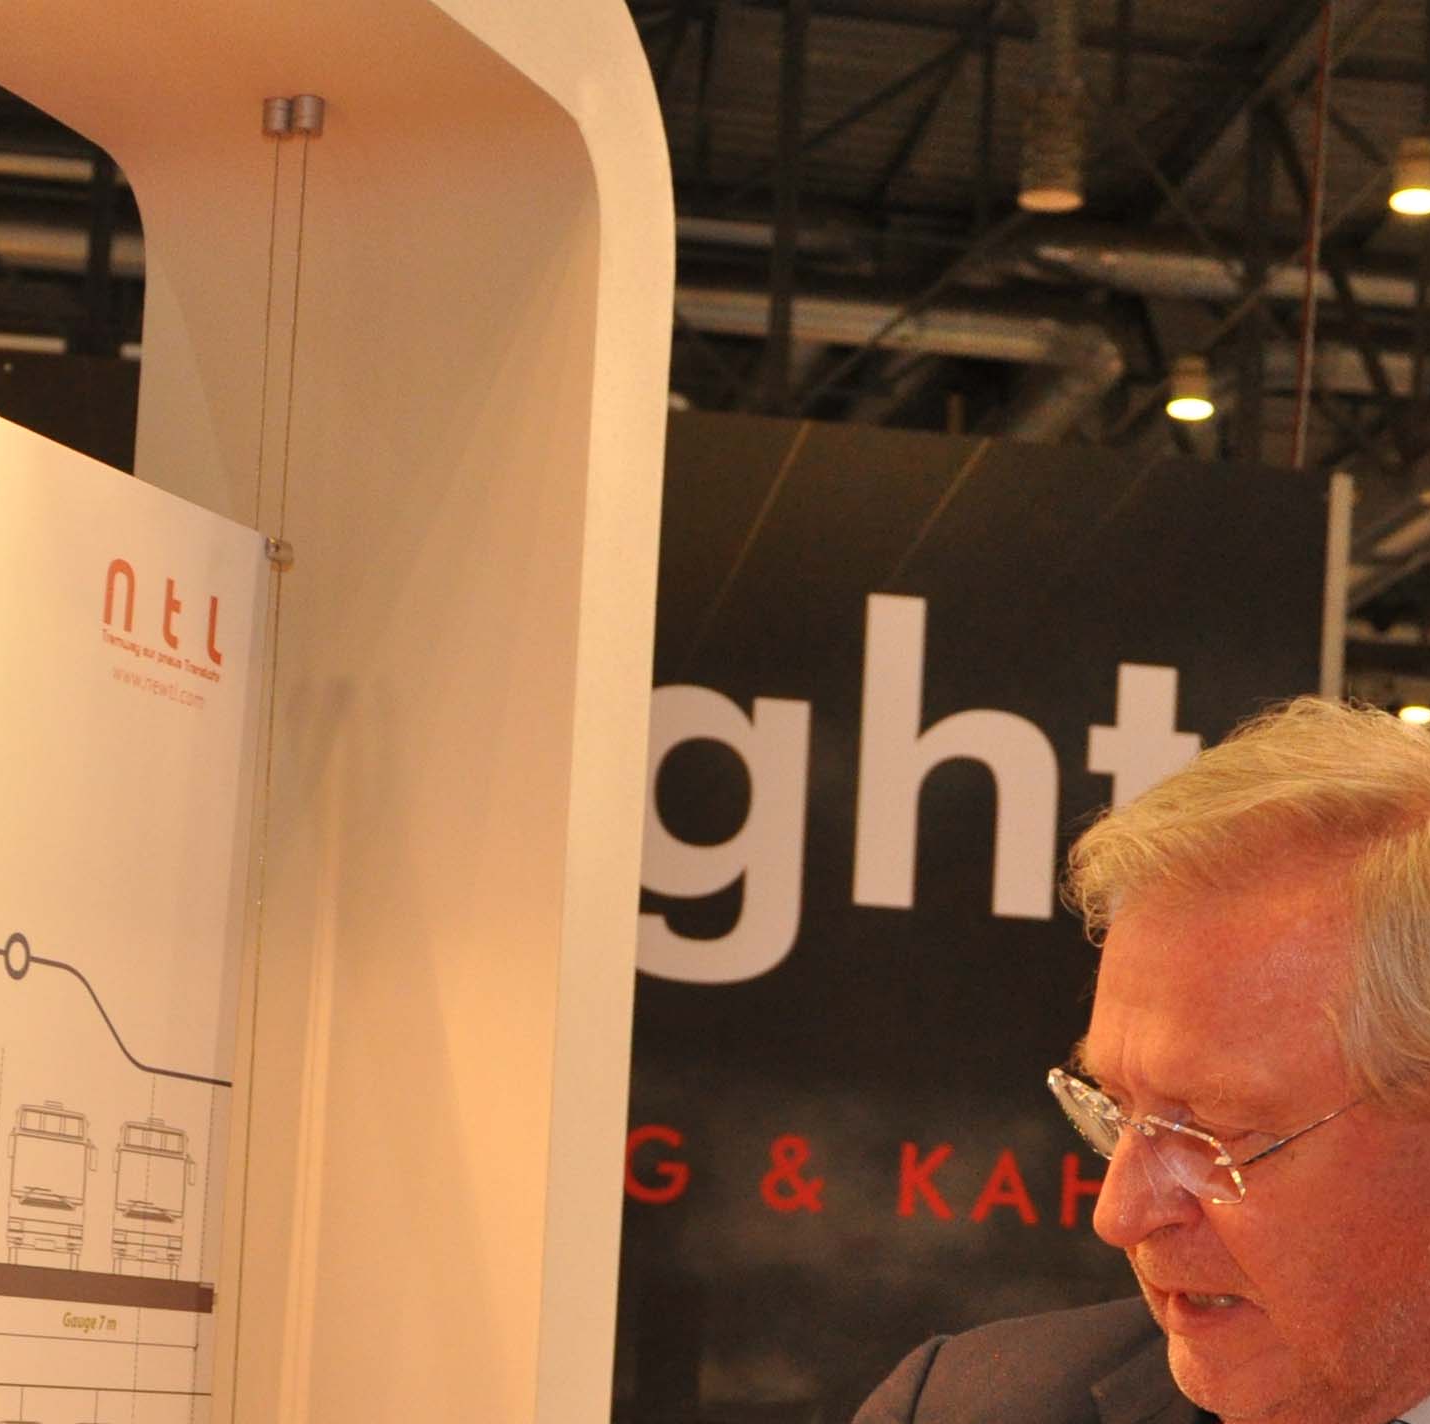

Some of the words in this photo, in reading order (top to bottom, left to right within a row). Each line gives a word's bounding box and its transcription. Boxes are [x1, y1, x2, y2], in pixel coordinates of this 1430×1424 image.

[634, 593, 1205, 985] ght
[760, 1132, 825, 1213] &
[62, 1312, 98, 1333] Gauge
